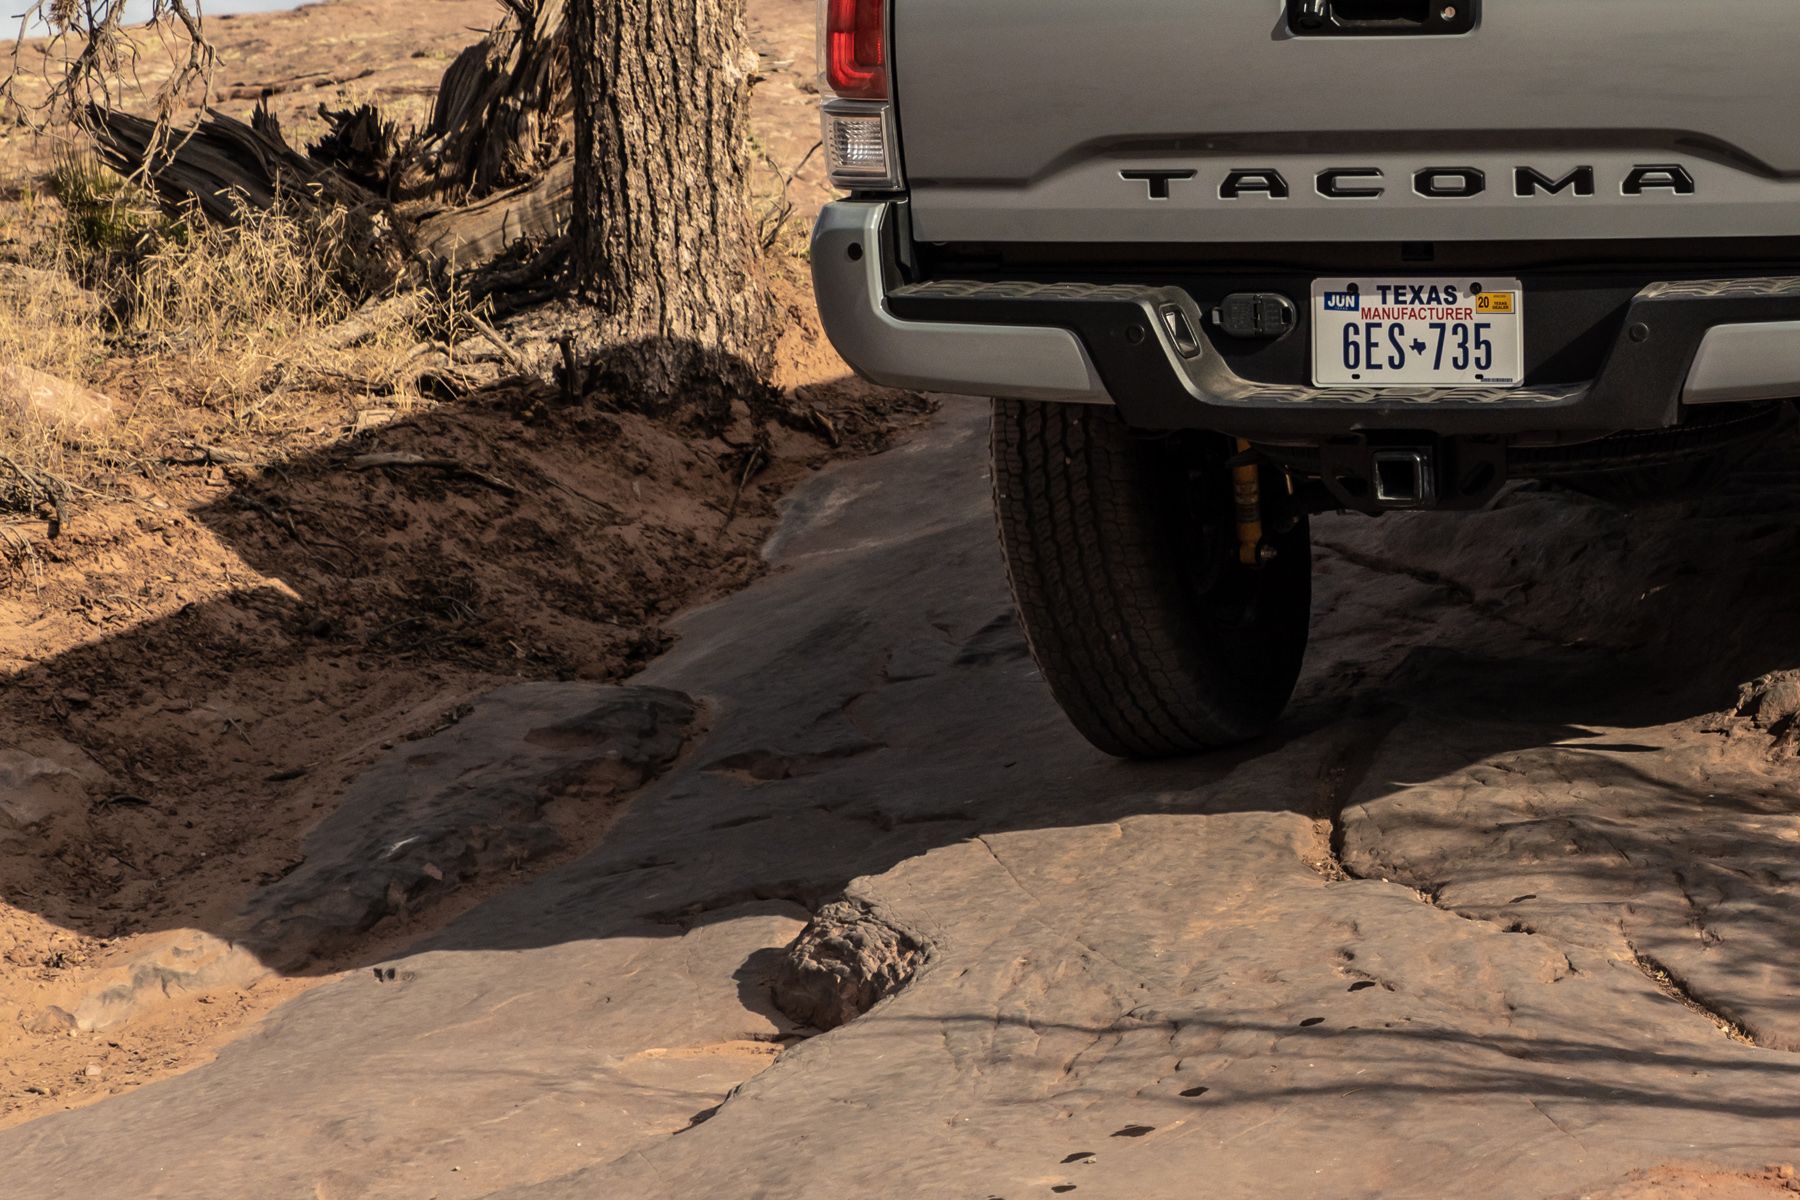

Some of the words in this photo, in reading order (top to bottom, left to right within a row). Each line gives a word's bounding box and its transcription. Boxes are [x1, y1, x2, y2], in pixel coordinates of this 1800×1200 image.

[1117, 163, 1696, 201] TACOMA
[1327, 294, 1356, 308] JUN
[1376, 284, 1458, 305] TEXAS
[1477, 296, 1490, 308] 20
[1360, 307, 1474, 321] MANUFACTURER
[1342, 322, 1405, 370] 6ES
[1429, 322, 1492, 370] 735
